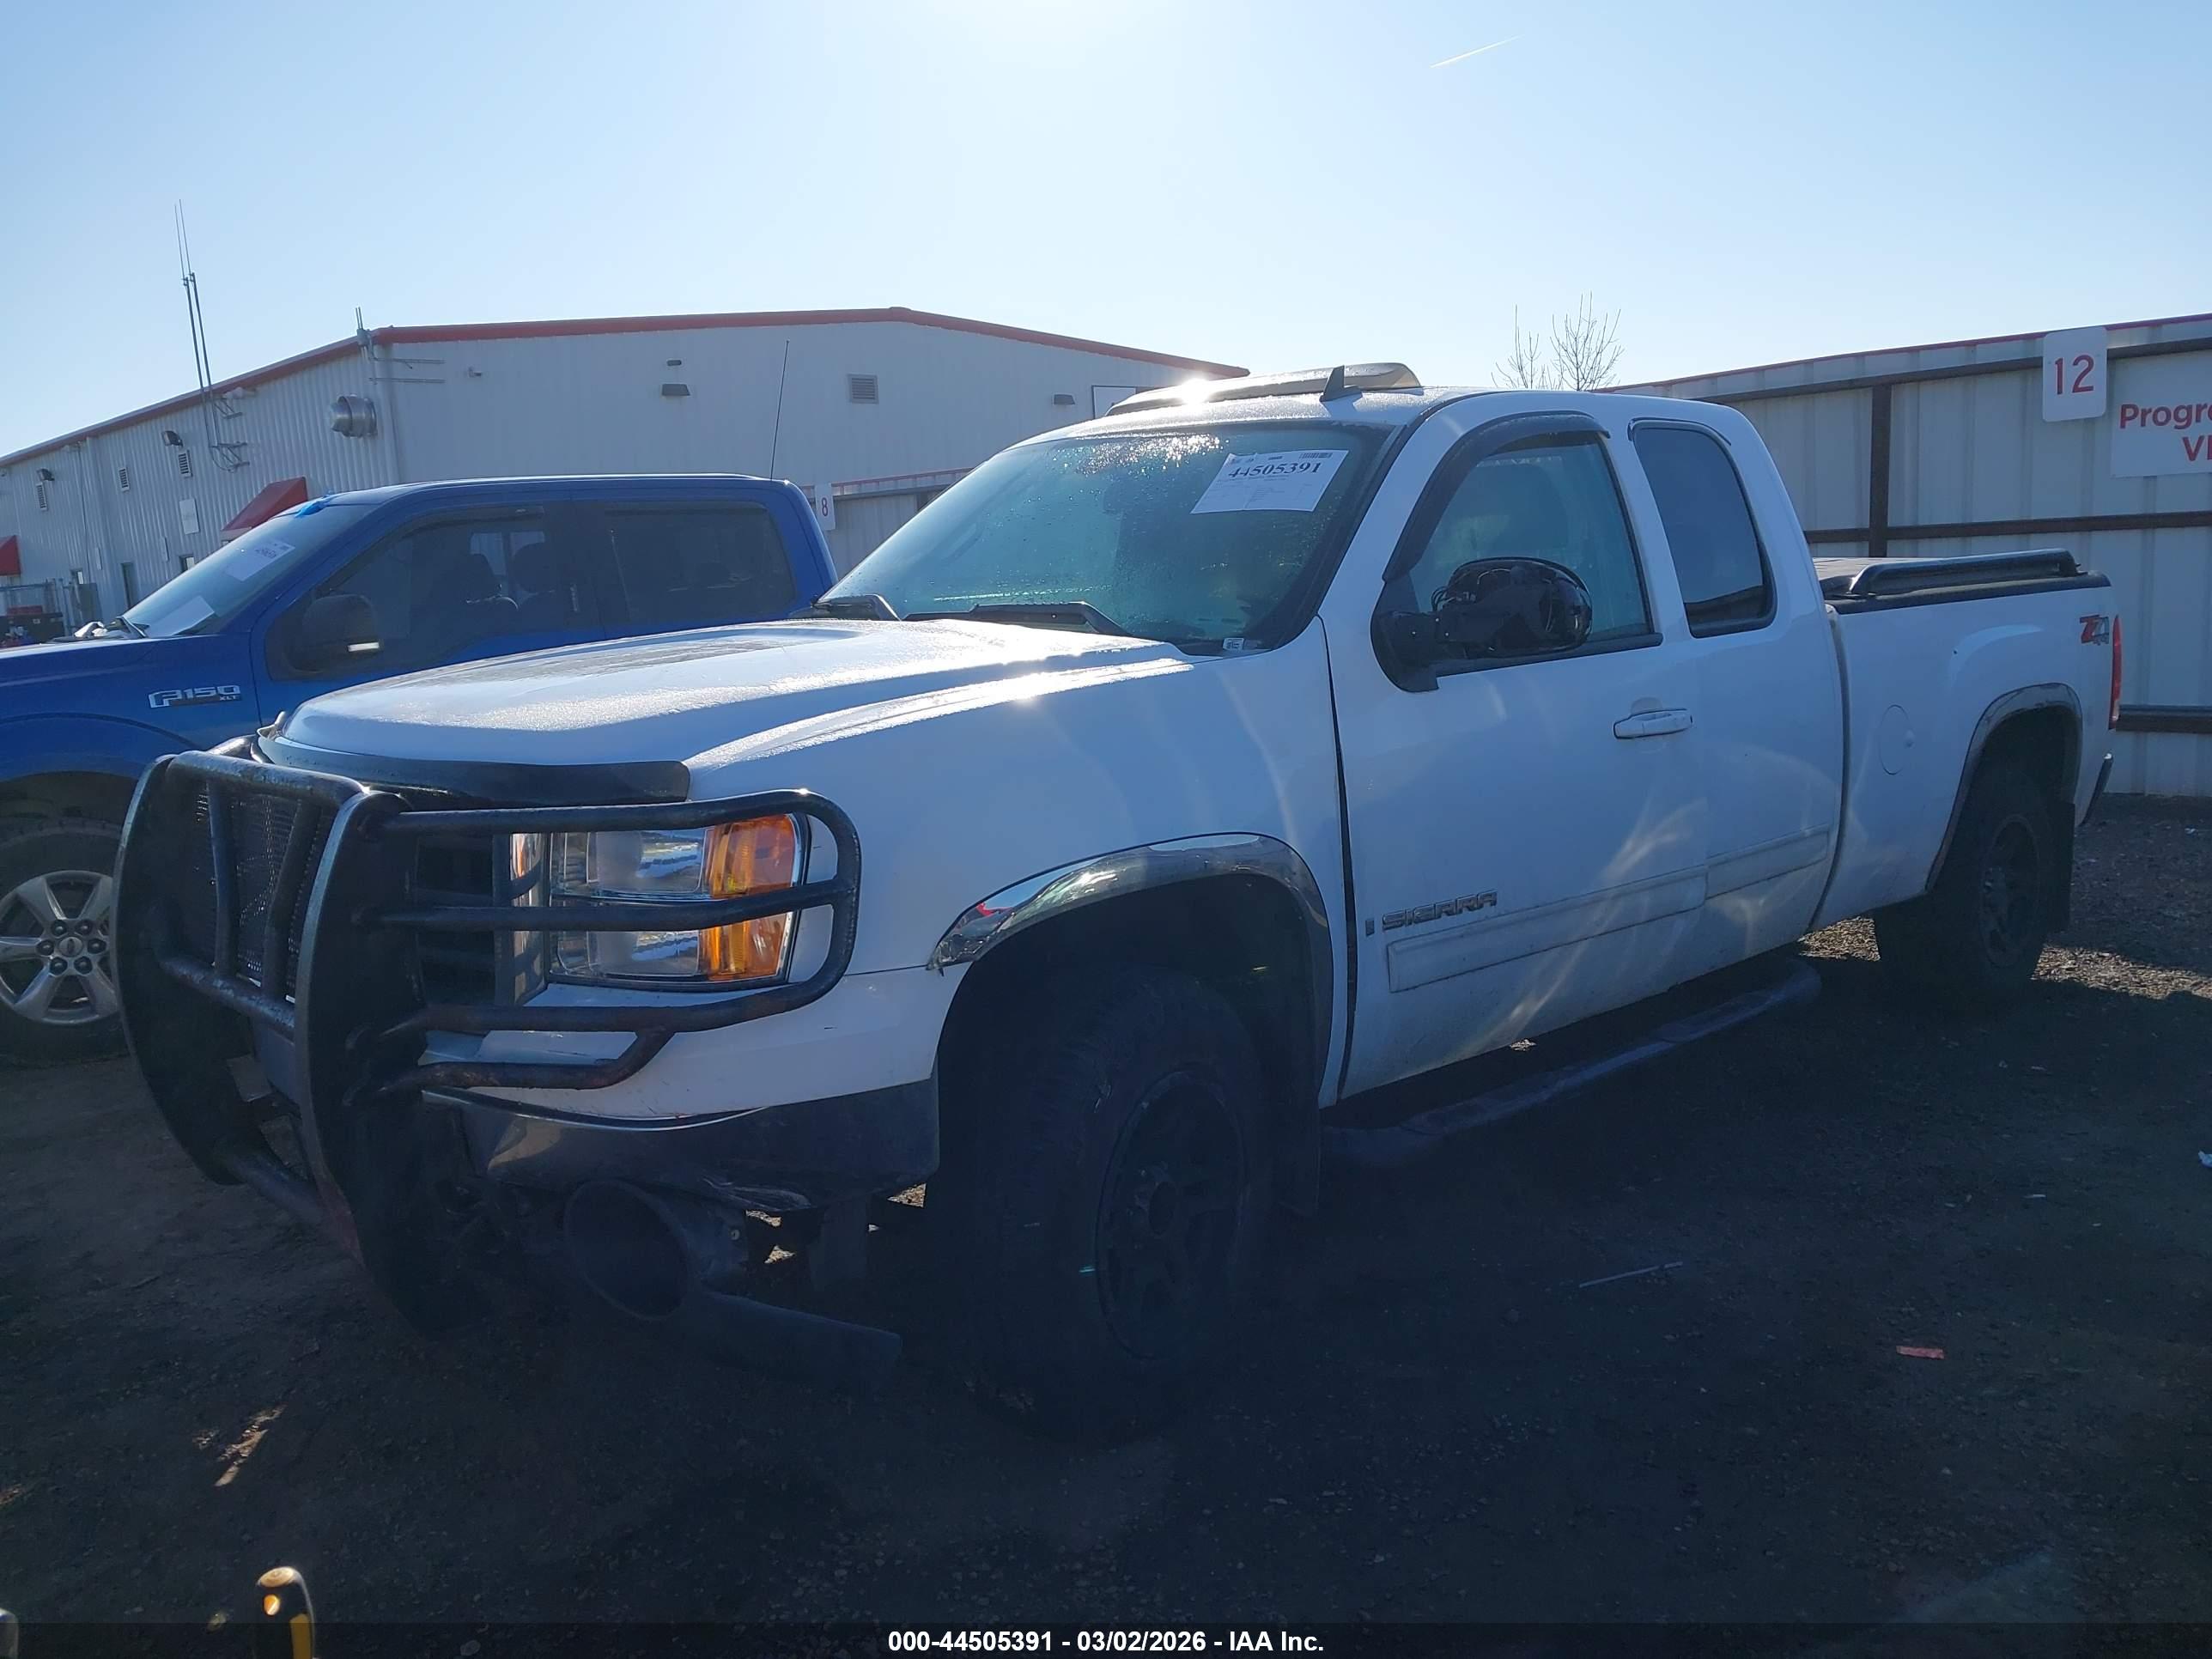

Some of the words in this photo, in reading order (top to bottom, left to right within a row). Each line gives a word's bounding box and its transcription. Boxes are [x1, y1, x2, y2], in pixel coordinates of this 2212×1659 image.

[2055, 355, 2095, 395] 12
[2119, 402, 2212, 430] Progr
[1228, 462, 1322, 478] 44505391
[821, 497, 829, 517] 8
[1382, 889, 1498, 931] SIERRA
